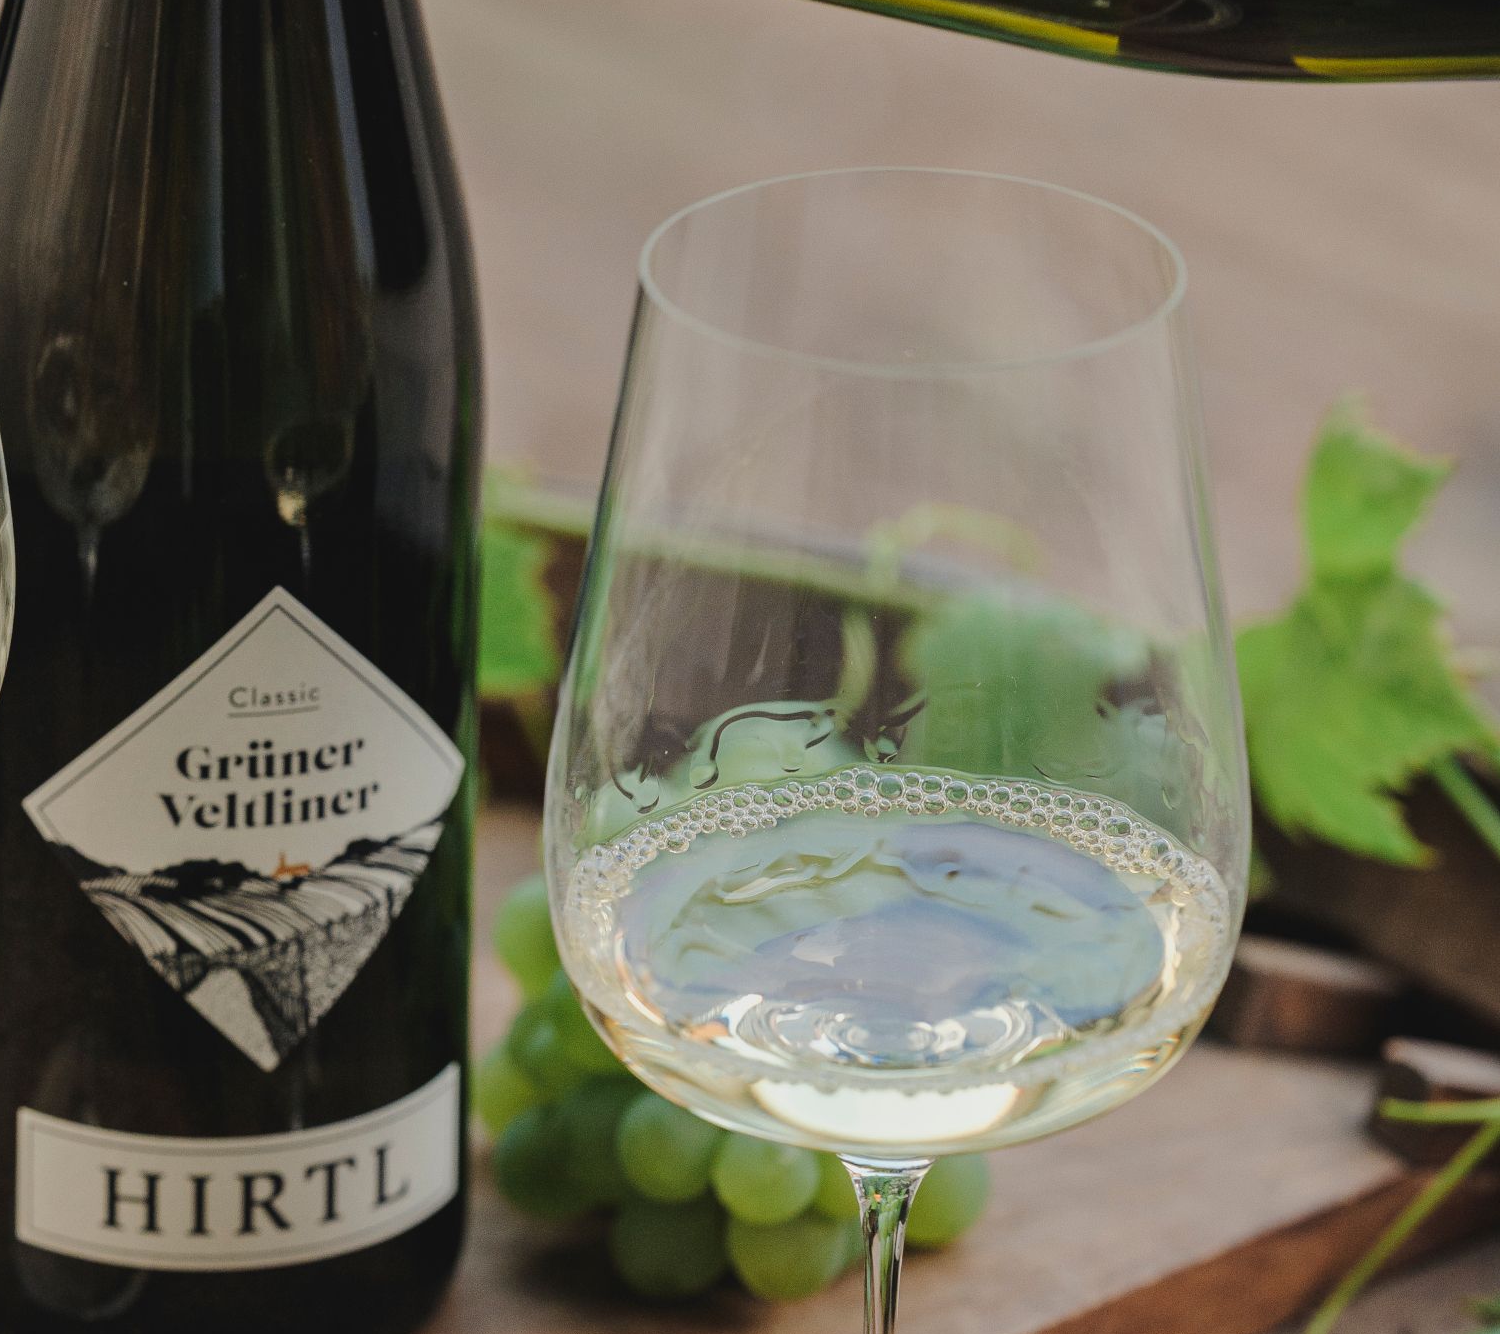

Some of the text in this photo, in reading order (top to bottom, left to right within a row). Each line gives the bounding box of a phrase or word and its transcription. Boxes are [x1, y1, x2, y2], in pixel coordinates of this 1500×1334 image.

[227, 681, 321, 709] Classic
[176, 737, 366, 781] Grüner
[158, 781, 381, 830] Veltliner
[102, 1140, 412, 1236] HIRTL
